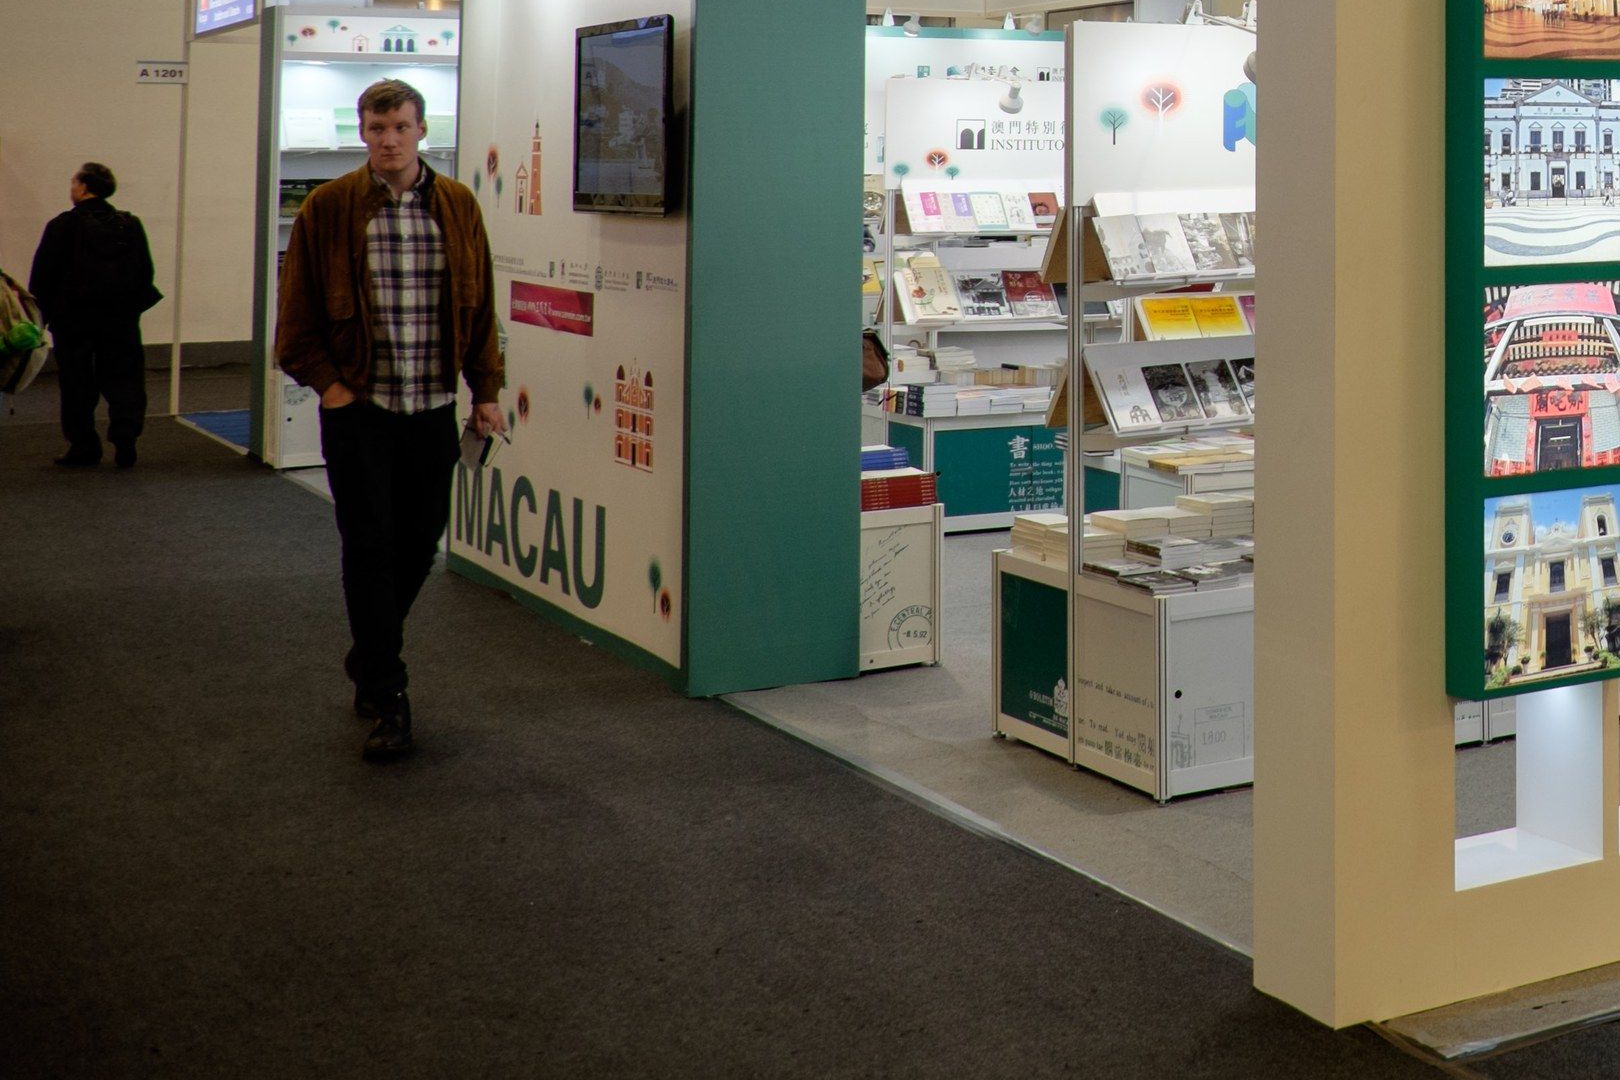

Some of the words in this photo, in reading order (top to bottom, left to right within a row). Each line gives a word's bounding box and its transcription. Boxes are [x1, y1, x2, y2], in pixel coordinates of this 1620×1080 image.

[140, 68, 150, 78] A
[154, 69, 184, 78] 1201
[991, 139, 1064, 151] INSTITUTO
[1008, 435, 1030, 459] 書
[456, 459, 606, 609] MACAU
